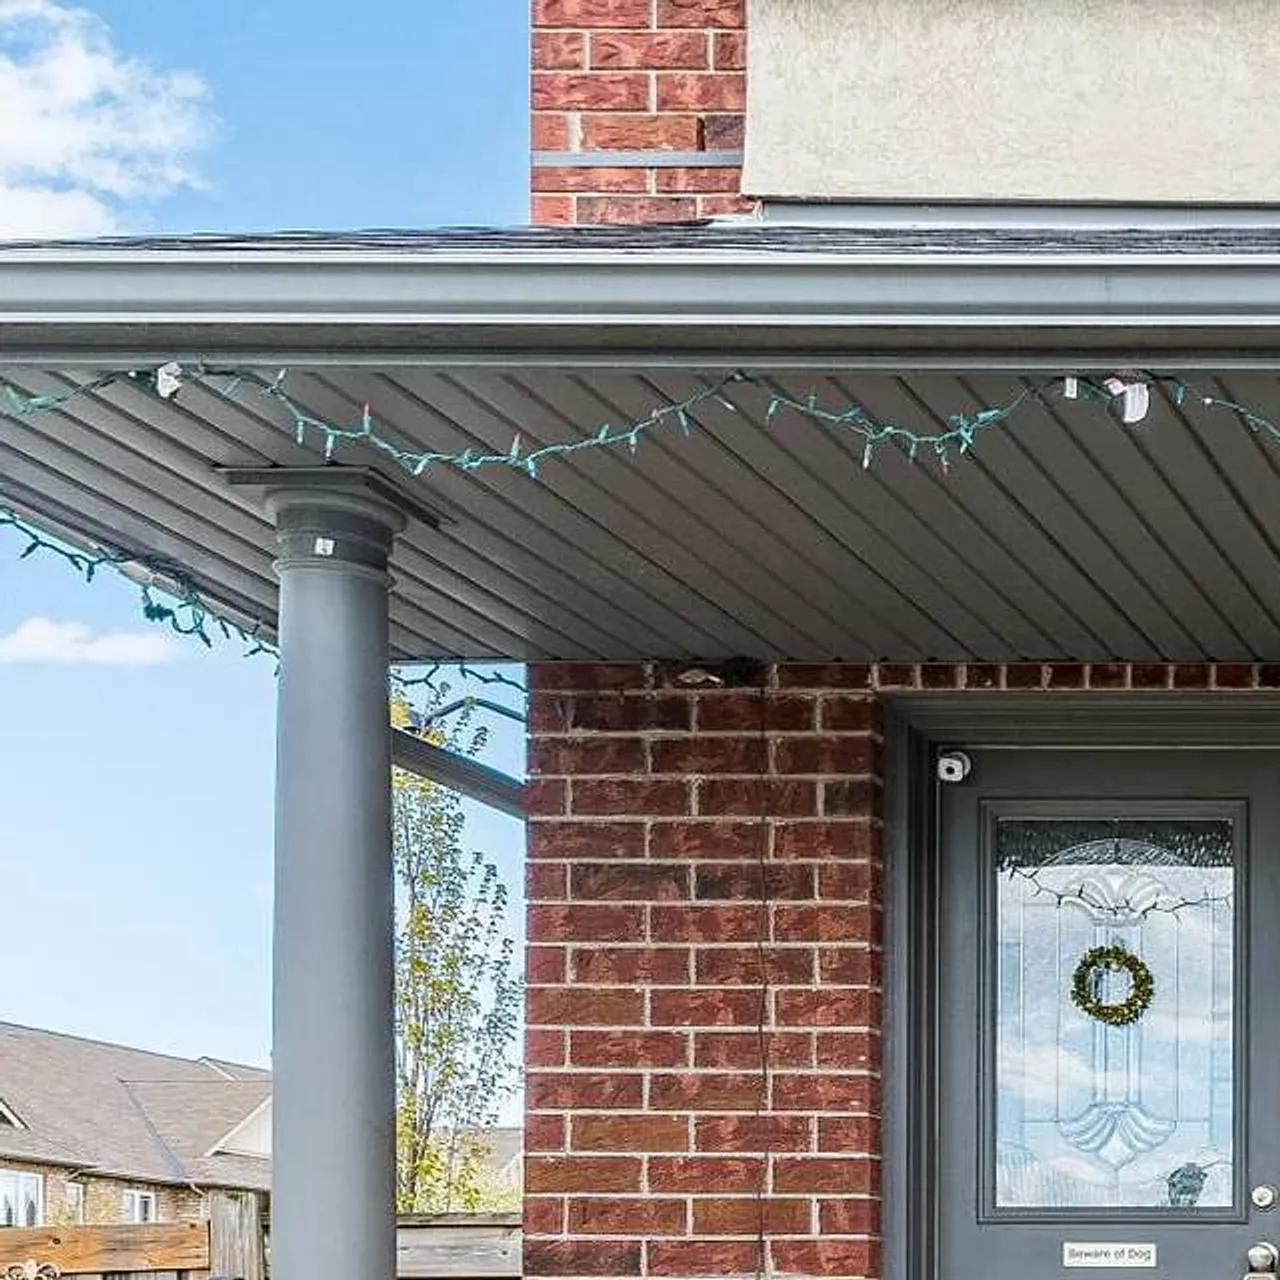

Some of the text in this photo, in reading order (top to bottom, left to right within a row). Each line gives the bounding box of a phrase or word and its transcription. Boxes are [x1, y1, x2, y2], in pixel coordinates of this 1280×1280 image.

[1068, 1248, 1151, 1261] Beware of Dog
